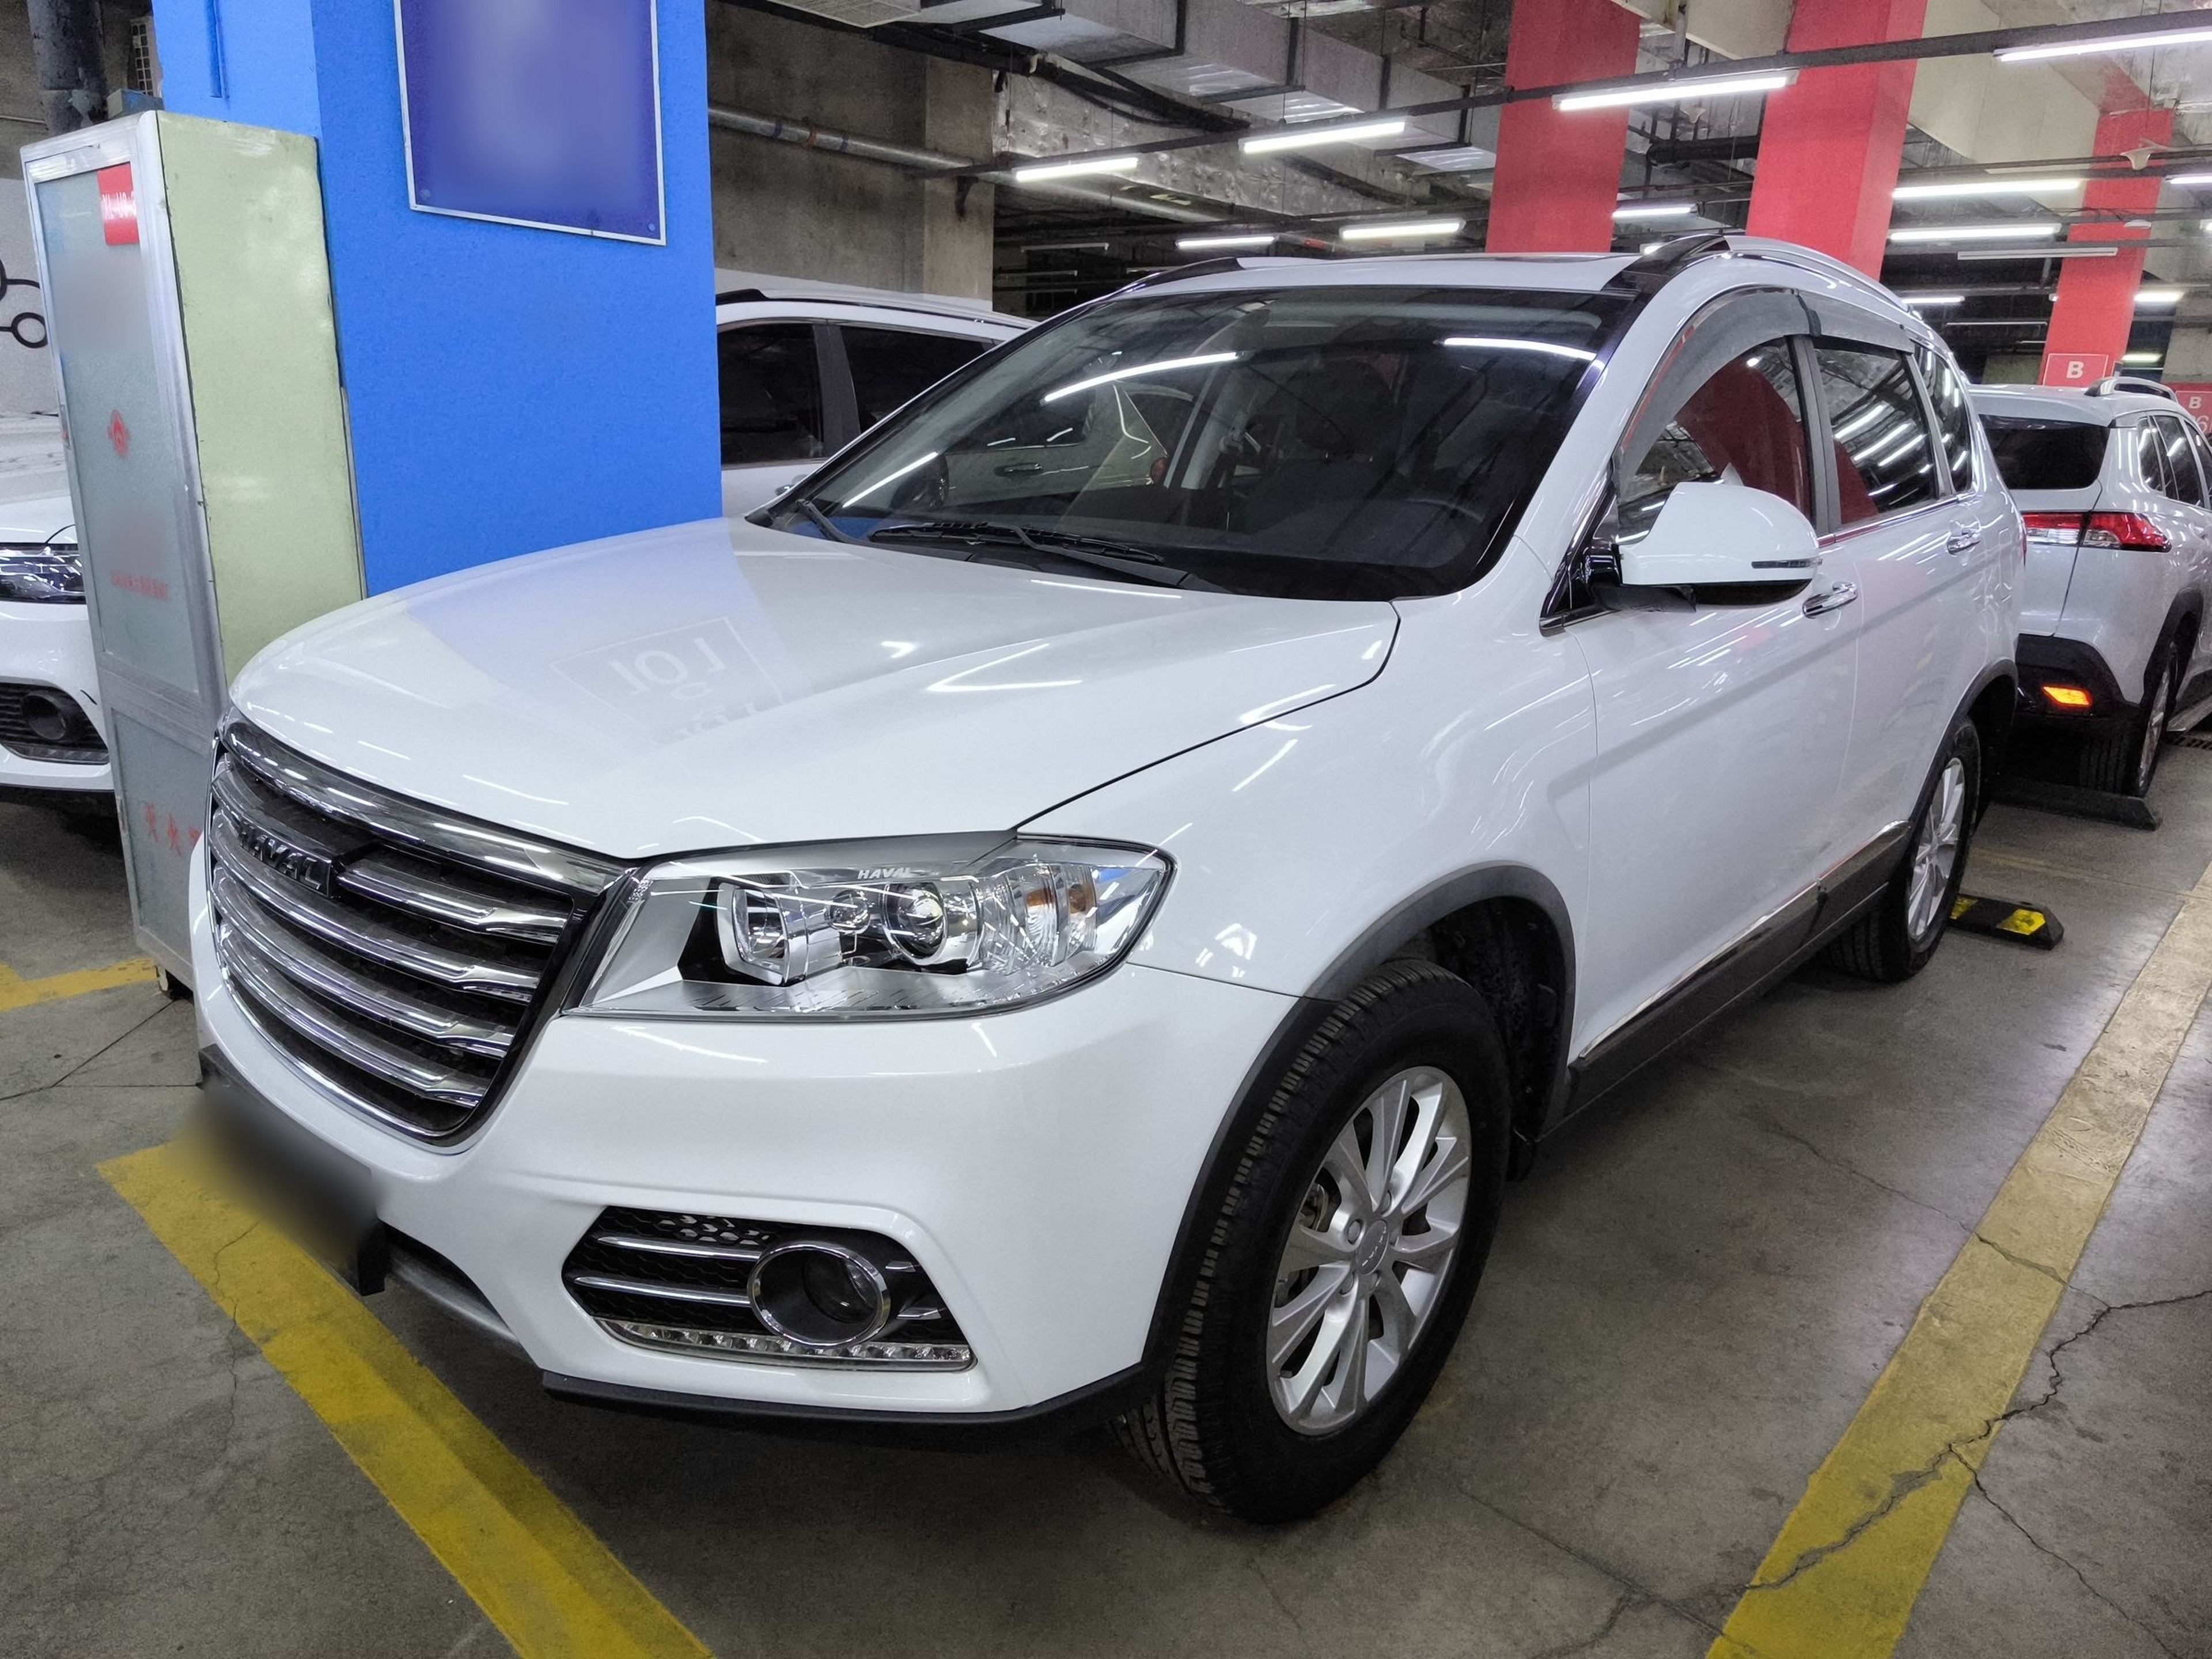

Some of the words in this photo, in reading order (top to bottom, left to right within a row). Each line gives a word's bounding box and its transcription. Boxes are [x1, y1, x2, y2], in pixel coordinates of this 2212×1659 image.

[2066, 361, 2084, 378] B
[2188, 396, 2202, 409] B
[857, 867, 914, 880] HAVAL
